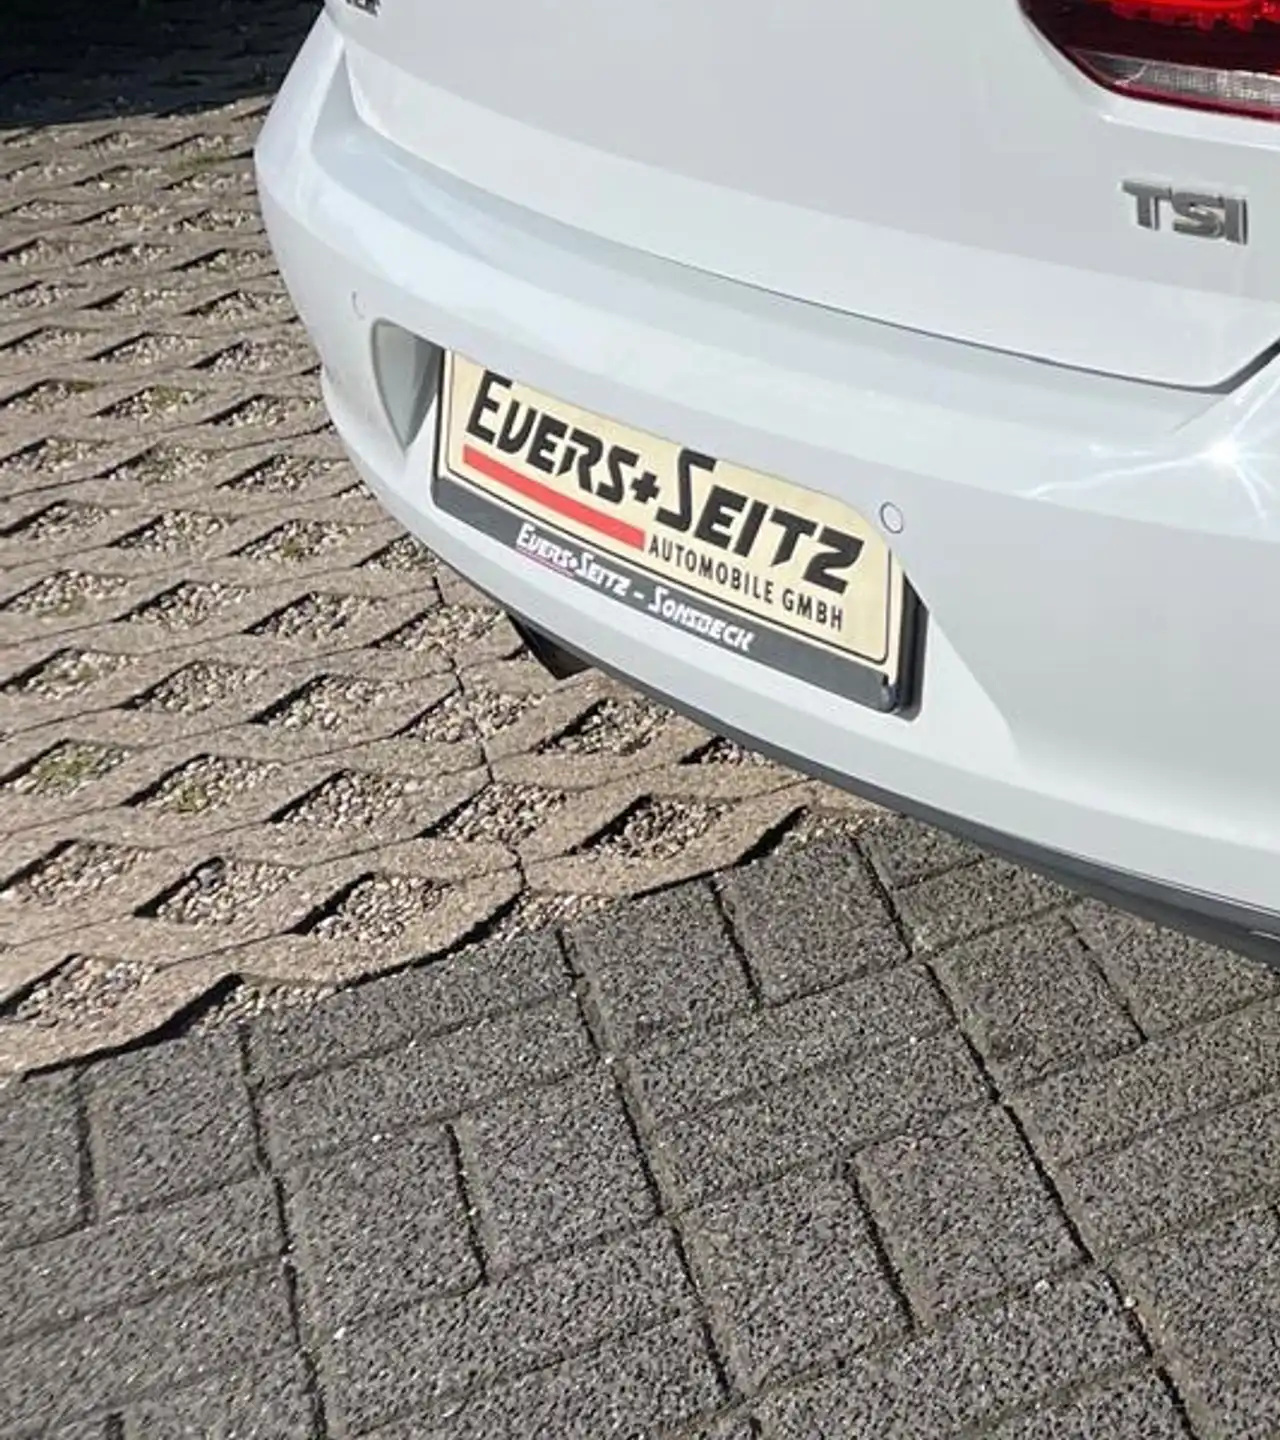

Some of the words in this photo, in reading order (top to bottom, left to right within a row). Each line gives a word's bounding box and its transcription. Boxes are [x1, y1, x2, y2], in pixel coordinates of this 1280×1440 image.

[1121, 178, 1249, 246] TSI
[648, 534, 774, 605] AUTOMOBILE
[782, 587, 843, 633] GMBH
[647, 585, 757, 653] SONSBECK
